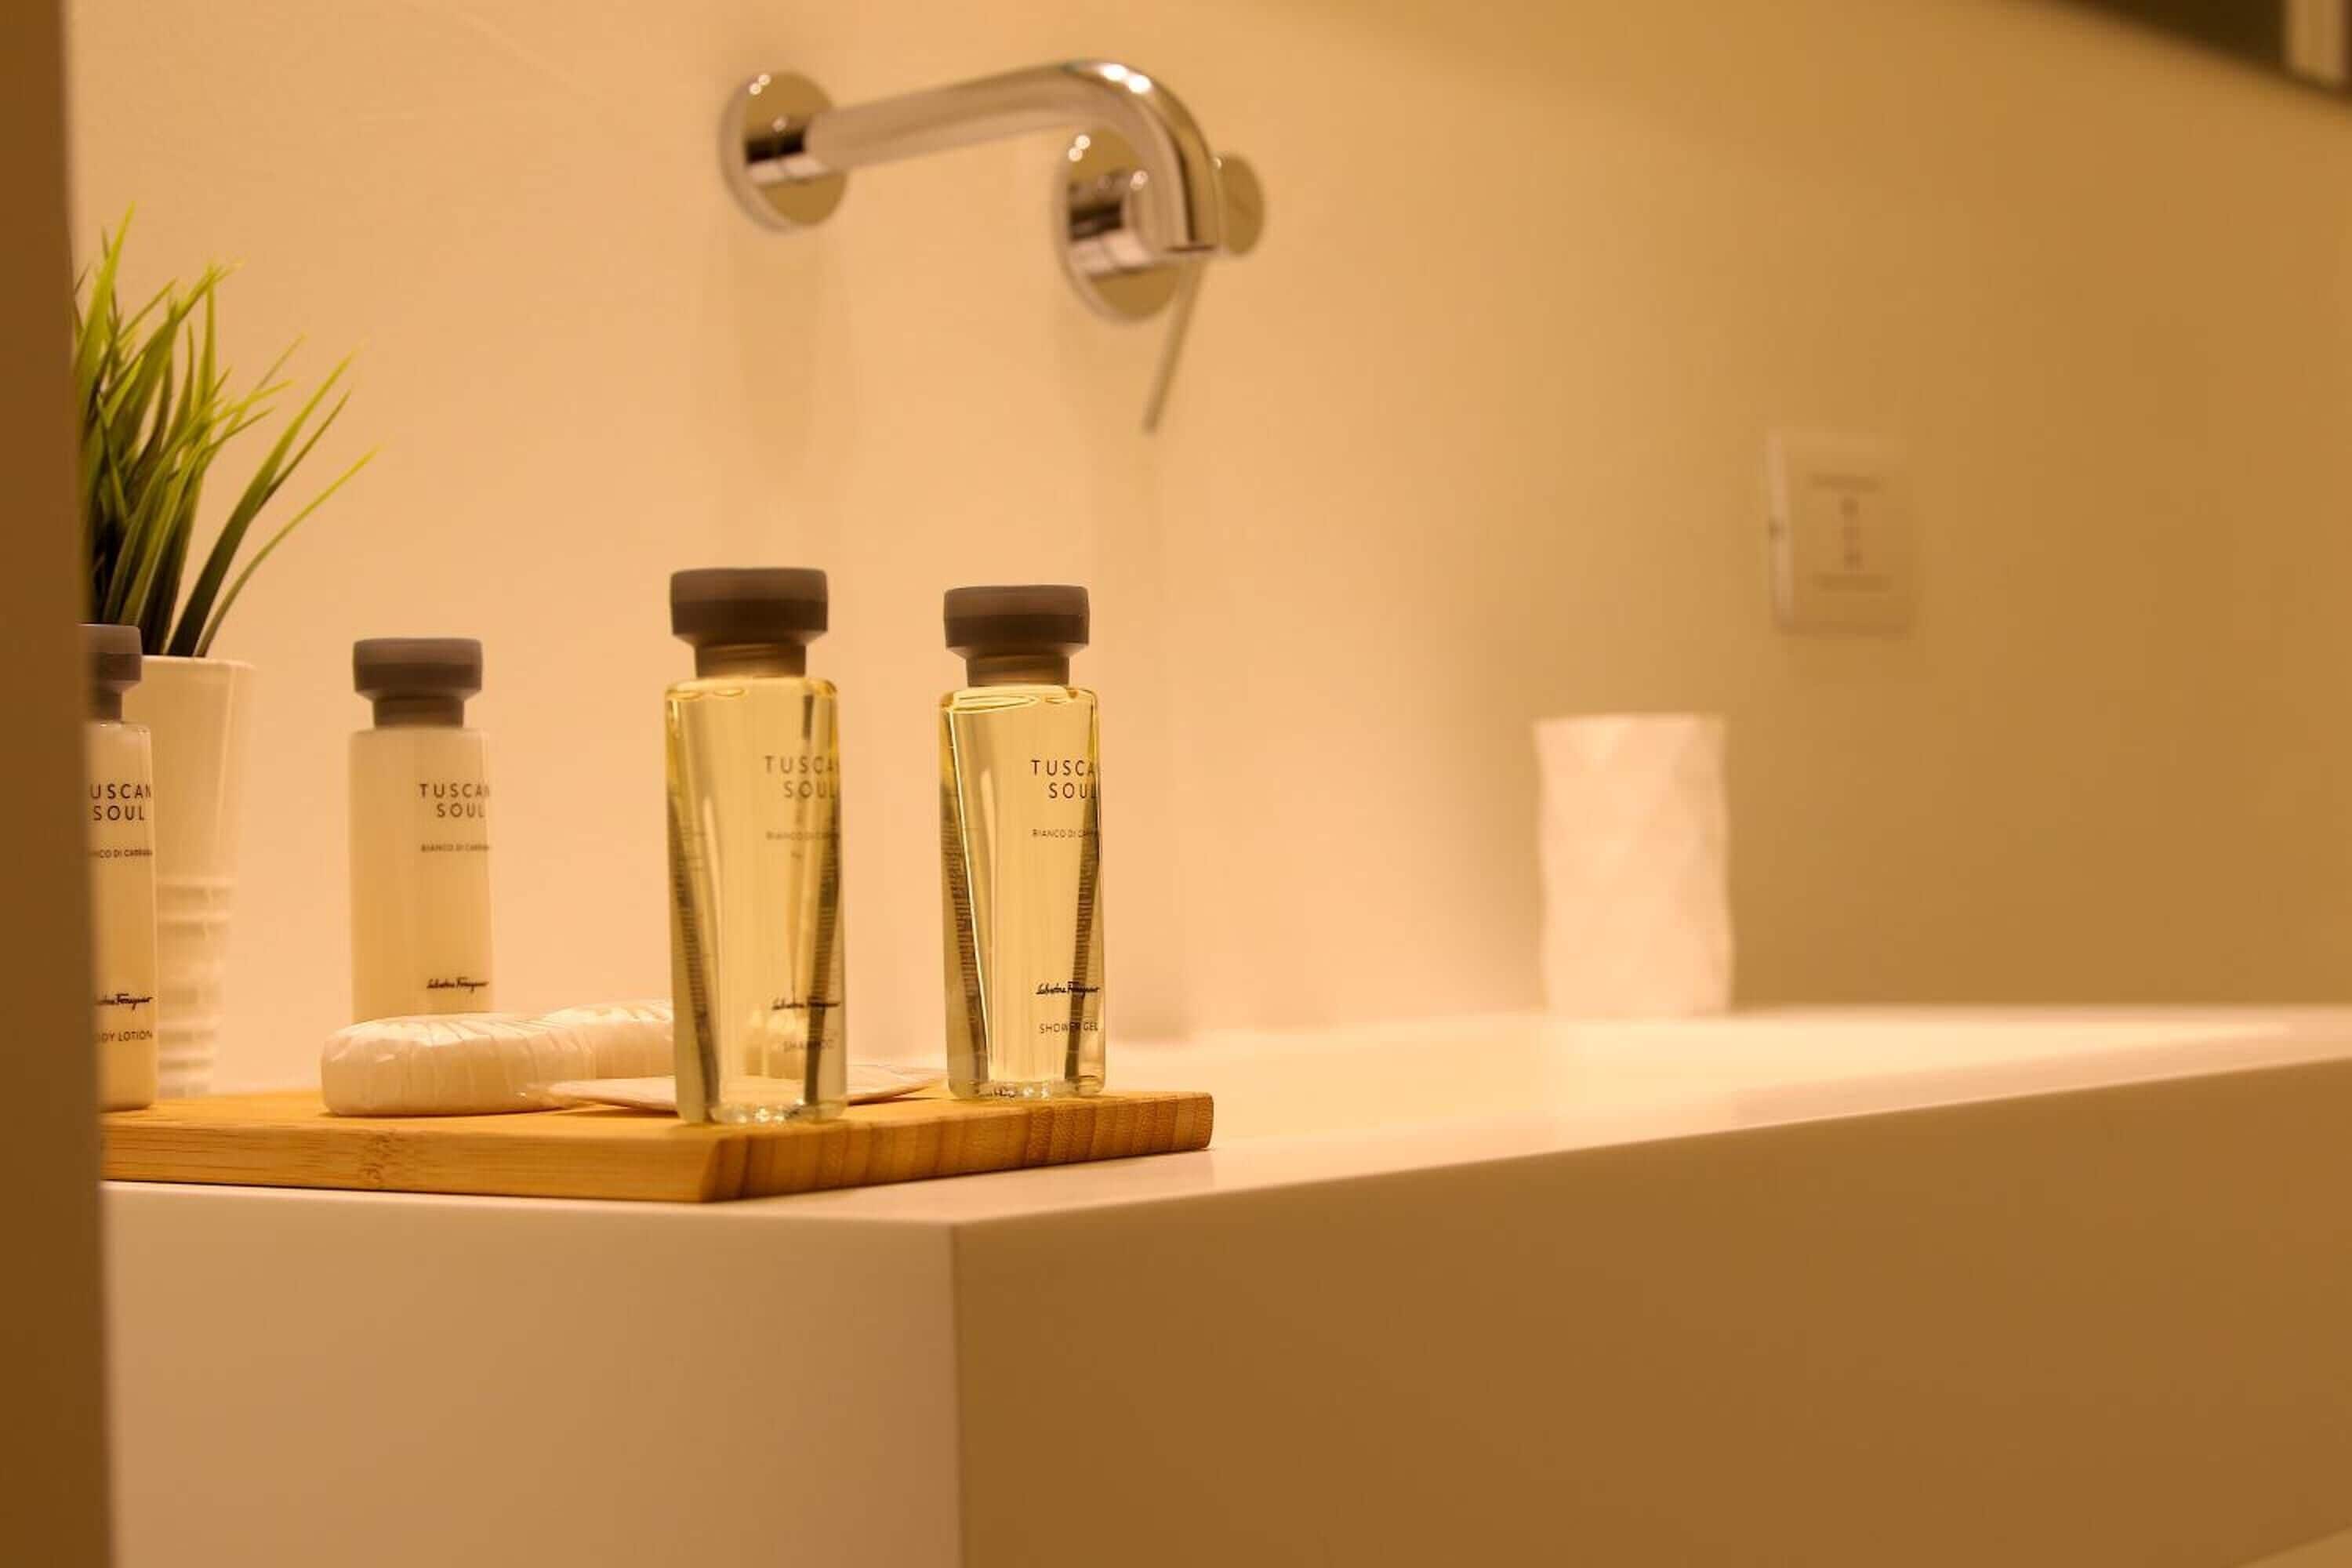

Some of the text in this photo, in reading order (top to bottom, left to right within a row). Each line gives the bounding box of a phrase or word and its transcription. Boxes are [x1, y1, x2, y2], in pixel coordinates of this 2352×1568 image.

[765, 756, 840, 774] TUSCA
[1031, 760, 1099, 776] TUSCA
[89, 783, 151, 799] USCAN
[783, 781, 836, 799] SOUL
[1049, 782, 1097, 798] SOUL
[93, 805, 144, 821] SOUL
[437, 803, 485, 818] SOUL
[118, 1030, 152, 1042] LOTION
